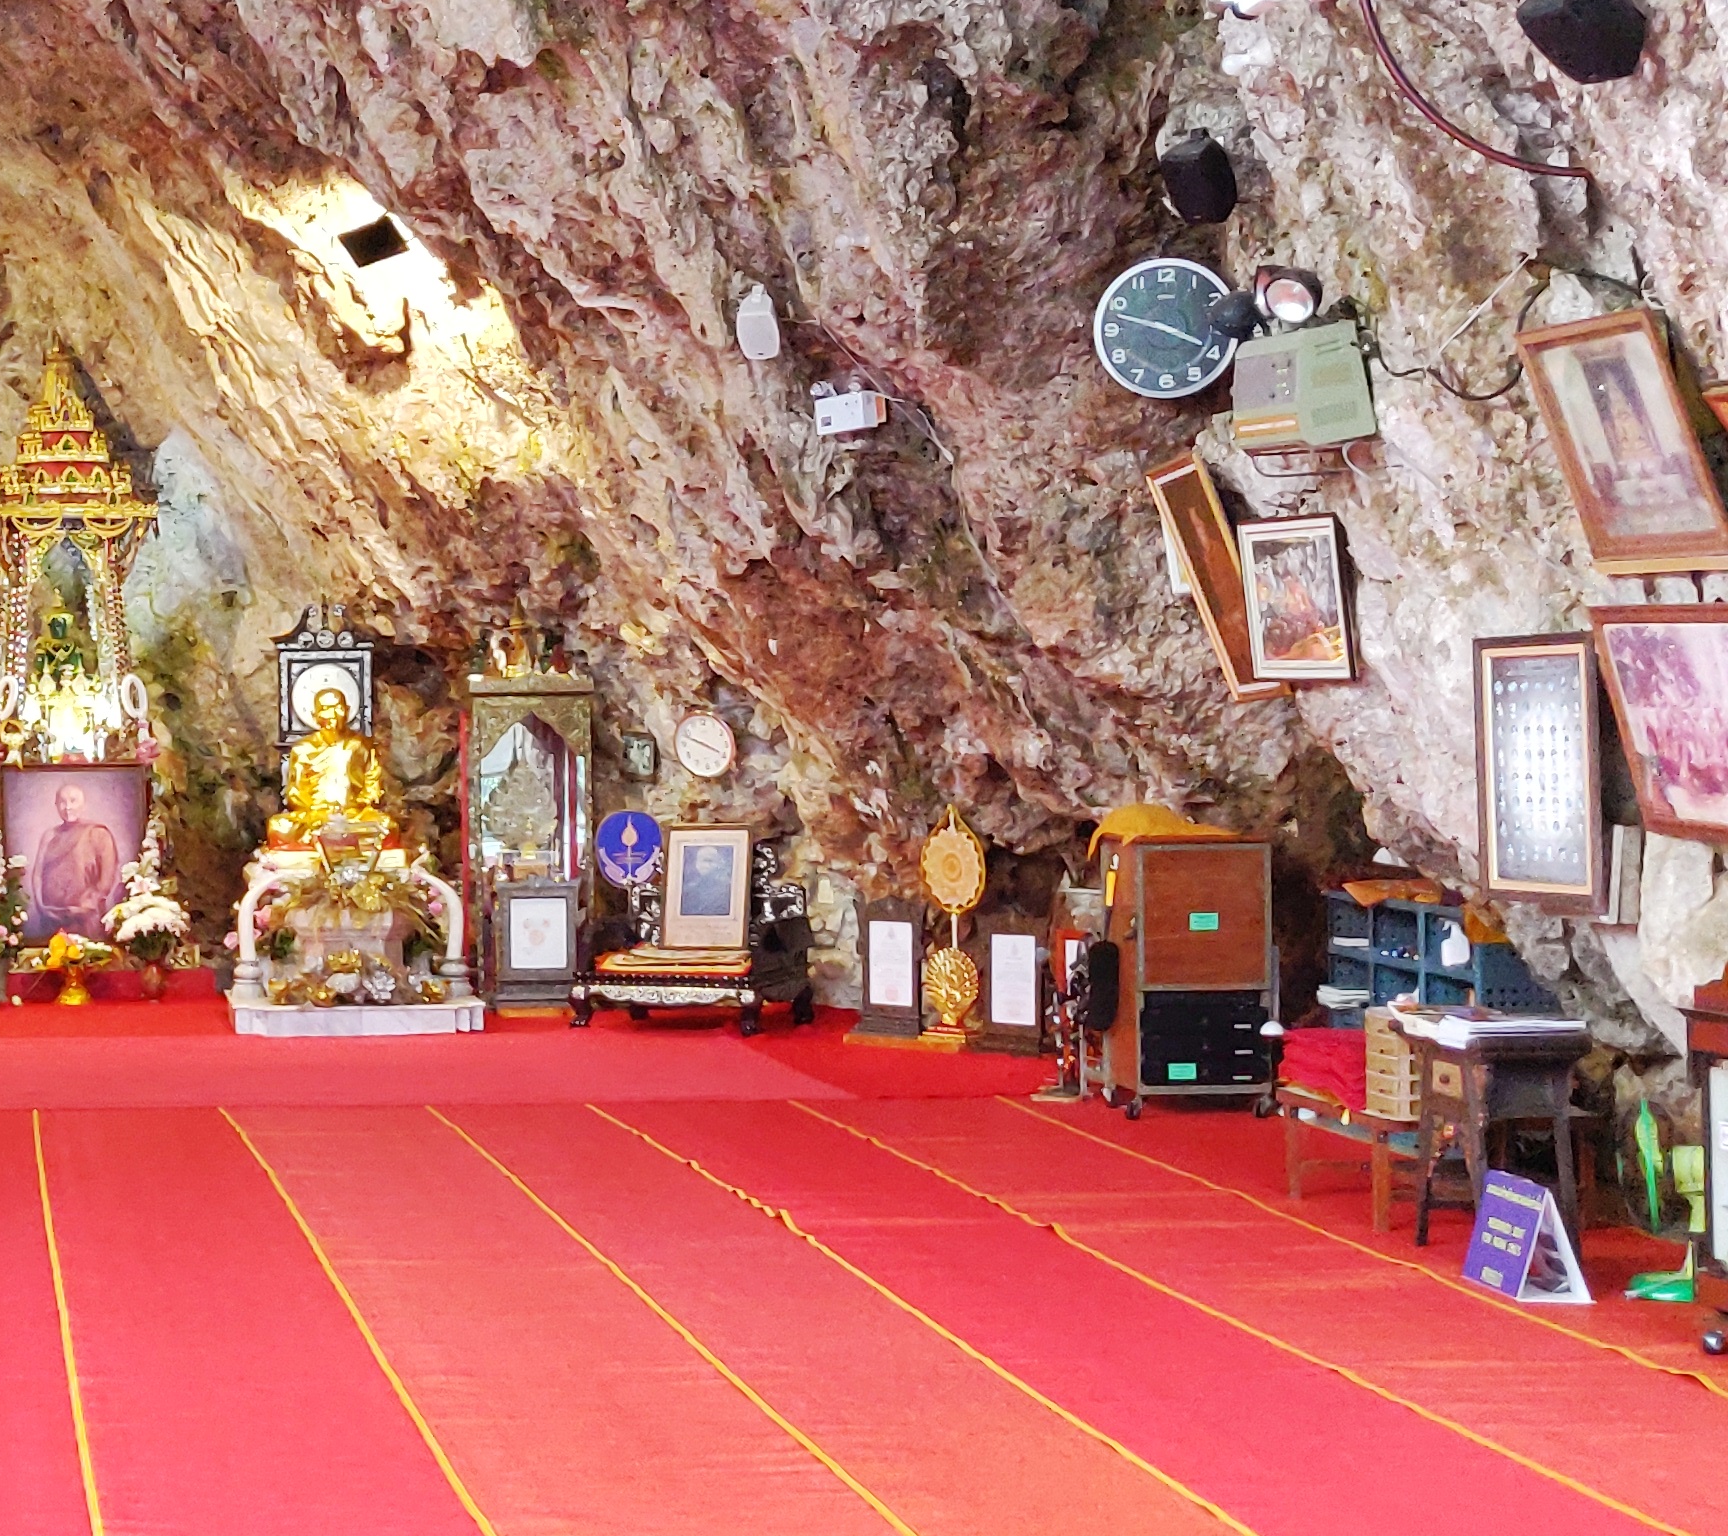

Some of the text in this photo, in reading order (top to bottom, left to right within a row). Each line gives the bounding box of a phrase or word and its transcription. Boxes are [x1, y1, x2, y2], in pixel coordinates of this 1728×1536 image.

[1131, 275, 1145, 290] 11
[1157, 268, 1176, 283] 12
[1191, 275, 1197, 290] 1
[1109, 296, 1128, 311] 10
[1104, 322, 1120, 338] 9
[1111, 348, 1126, 364] 8
[1205, 344, 1221, 361] 4
[1129, 368, 1145, 384] 7
[1158, 373, 1175, 389] 6
[1186, 366, 1202, 382] 5
